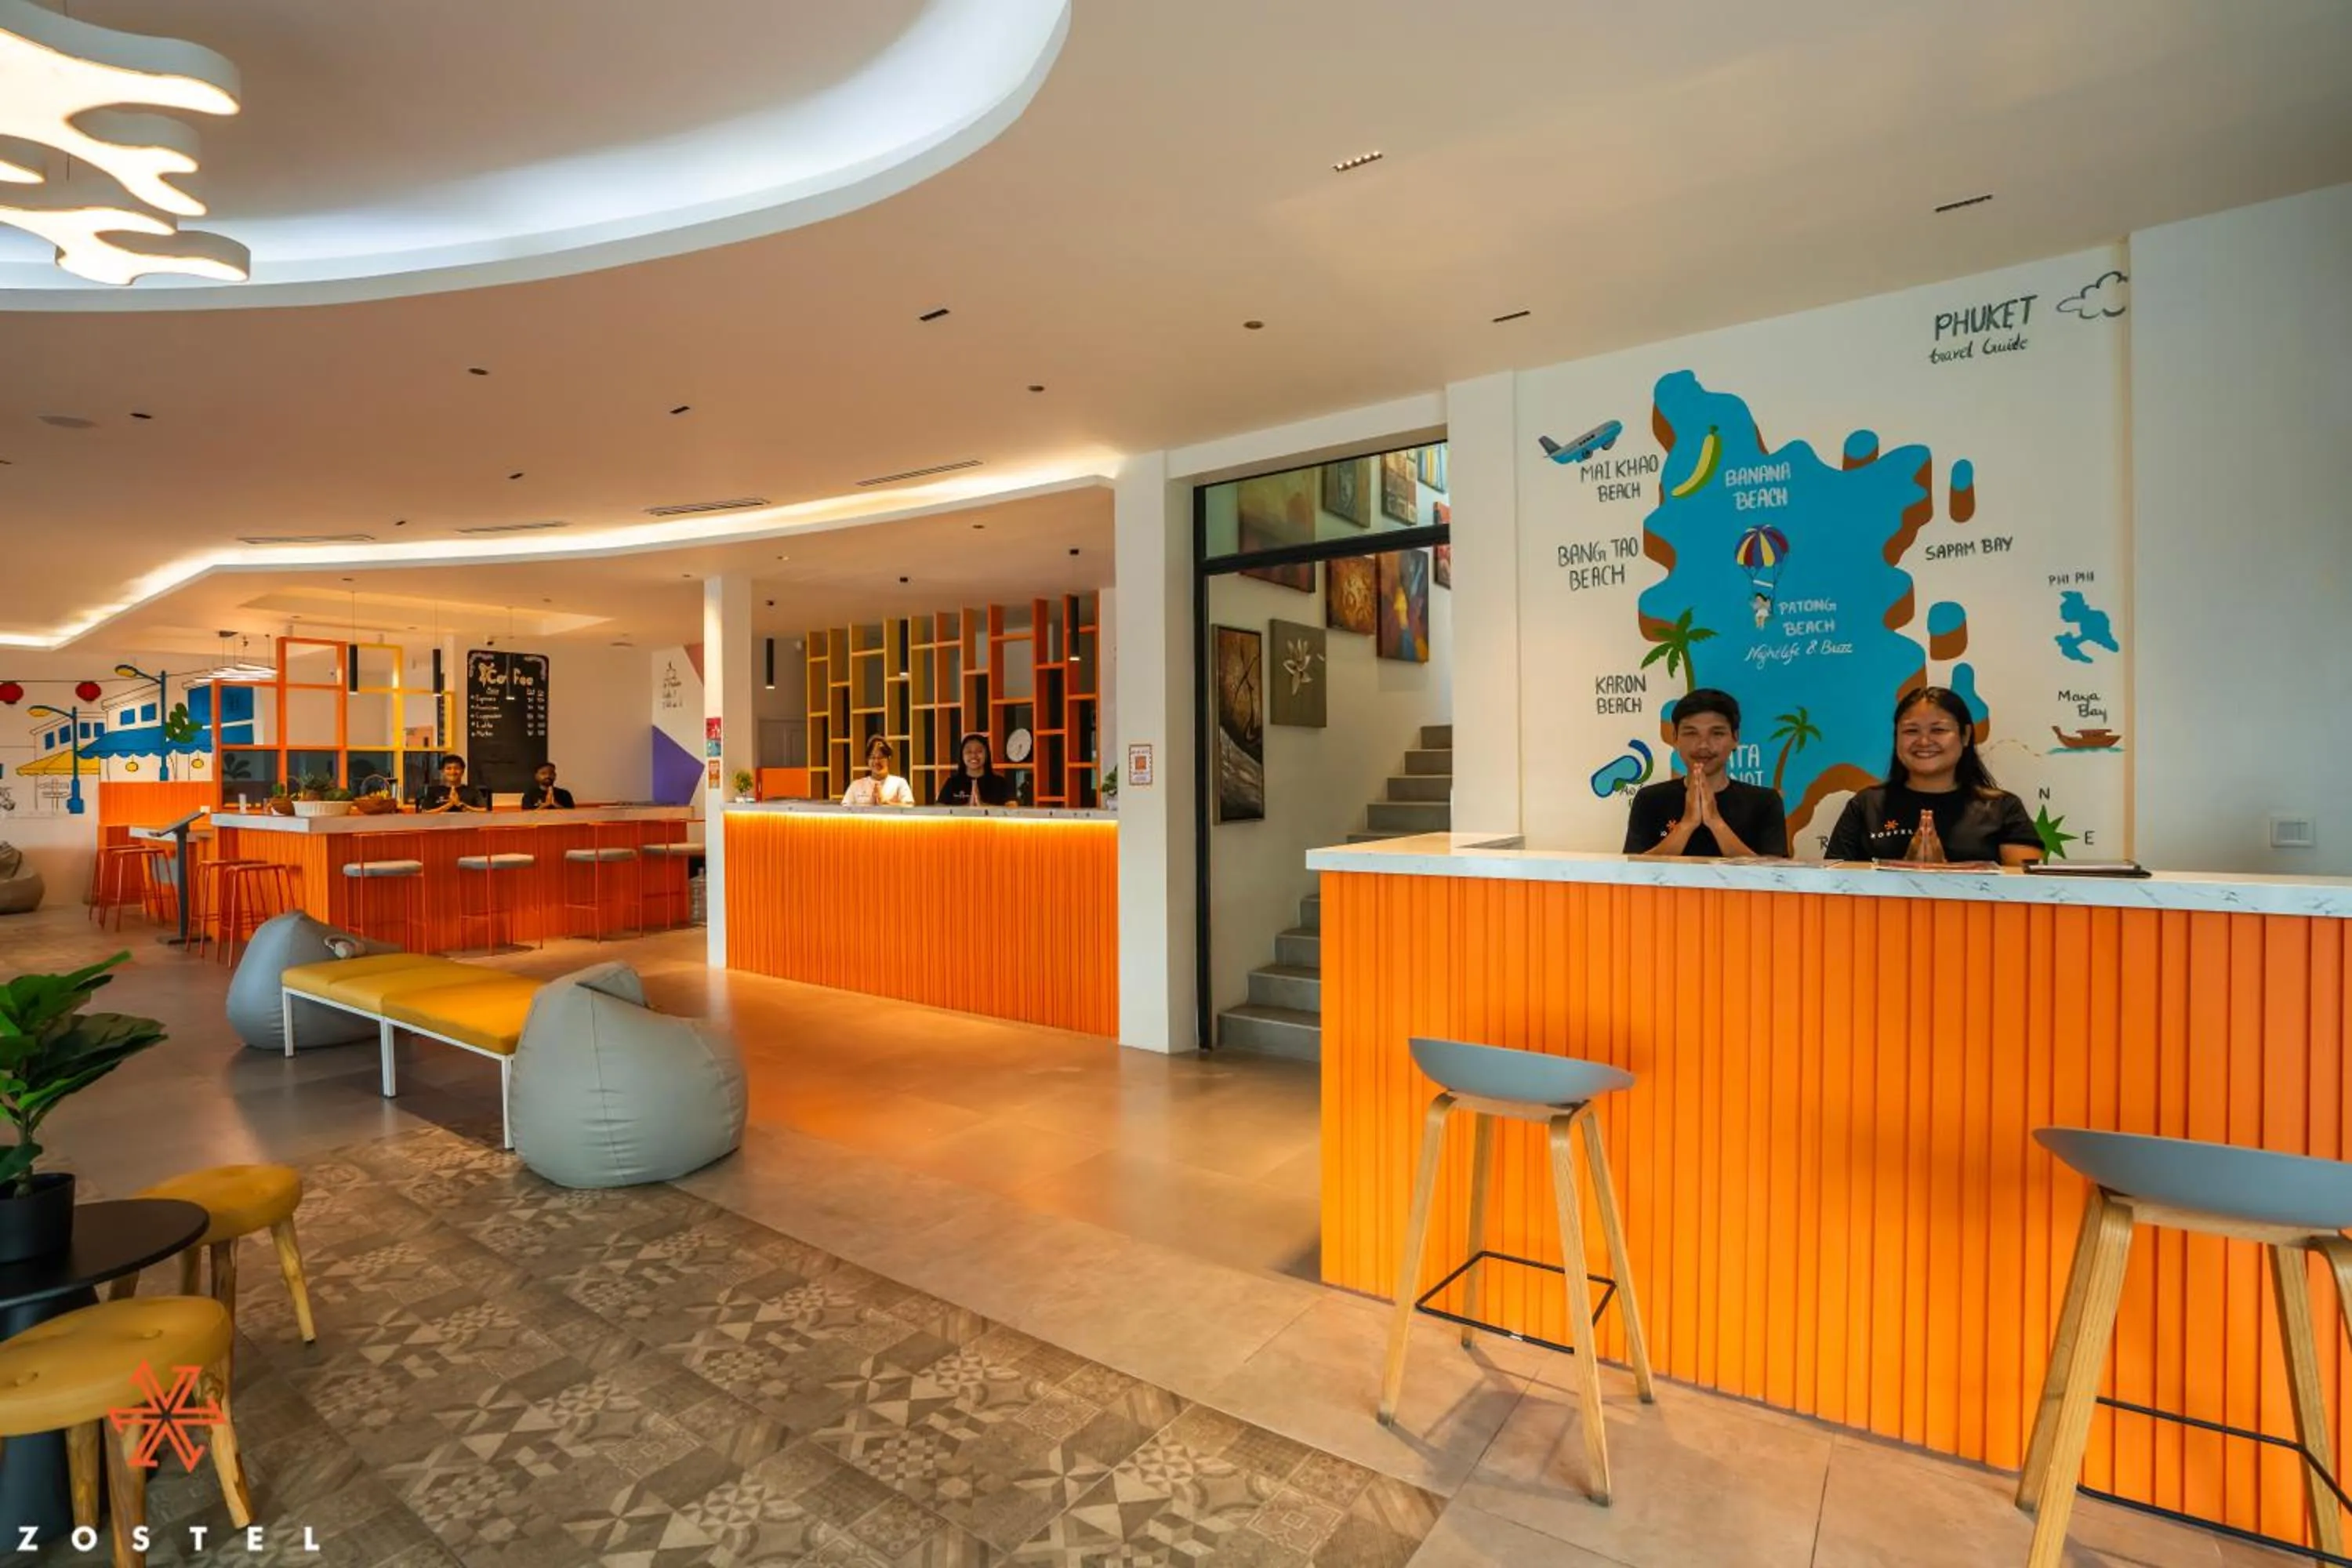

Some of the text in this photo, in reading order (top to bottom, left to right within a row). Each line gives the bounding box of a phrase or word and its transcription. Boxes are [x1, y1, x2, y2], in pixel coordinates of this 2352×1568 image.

[1935, 294, 2038, 341] PHUKET
[1982, 332, 2029, 355] Guide
[1580, 454, 1659, 482] MAI KHAO
[1726, 461, 1791, 488] BANANA
[1597, 482, 1640, 503] BEACH
[1733, 487, 1788, 510] BEACH
[1558, 536, 1639, 567] BANG TAO
[1925, 536, 2013, 561] SAPAM BAY
[1569, 564, 1624, 591] BEACH
[2048, 571, 2095, 586] PHI PHI
[1778, 597, 1837, 615] PATONG
[1783, 618, 1835, 637] BEACH
[1806, 639, 1818, 655] &
[1820, 640, 1853, 655] Buzz
[1595, 673, 1646, 695] KARON
[1597, 697, 1642, 714] BEACH
[2057, 689, 2101, 705] Maya
[2077, 703, 2107, 724] Bay
[2039, 786, 2050, 800] N
[2085, 830, 2096, 845] E
